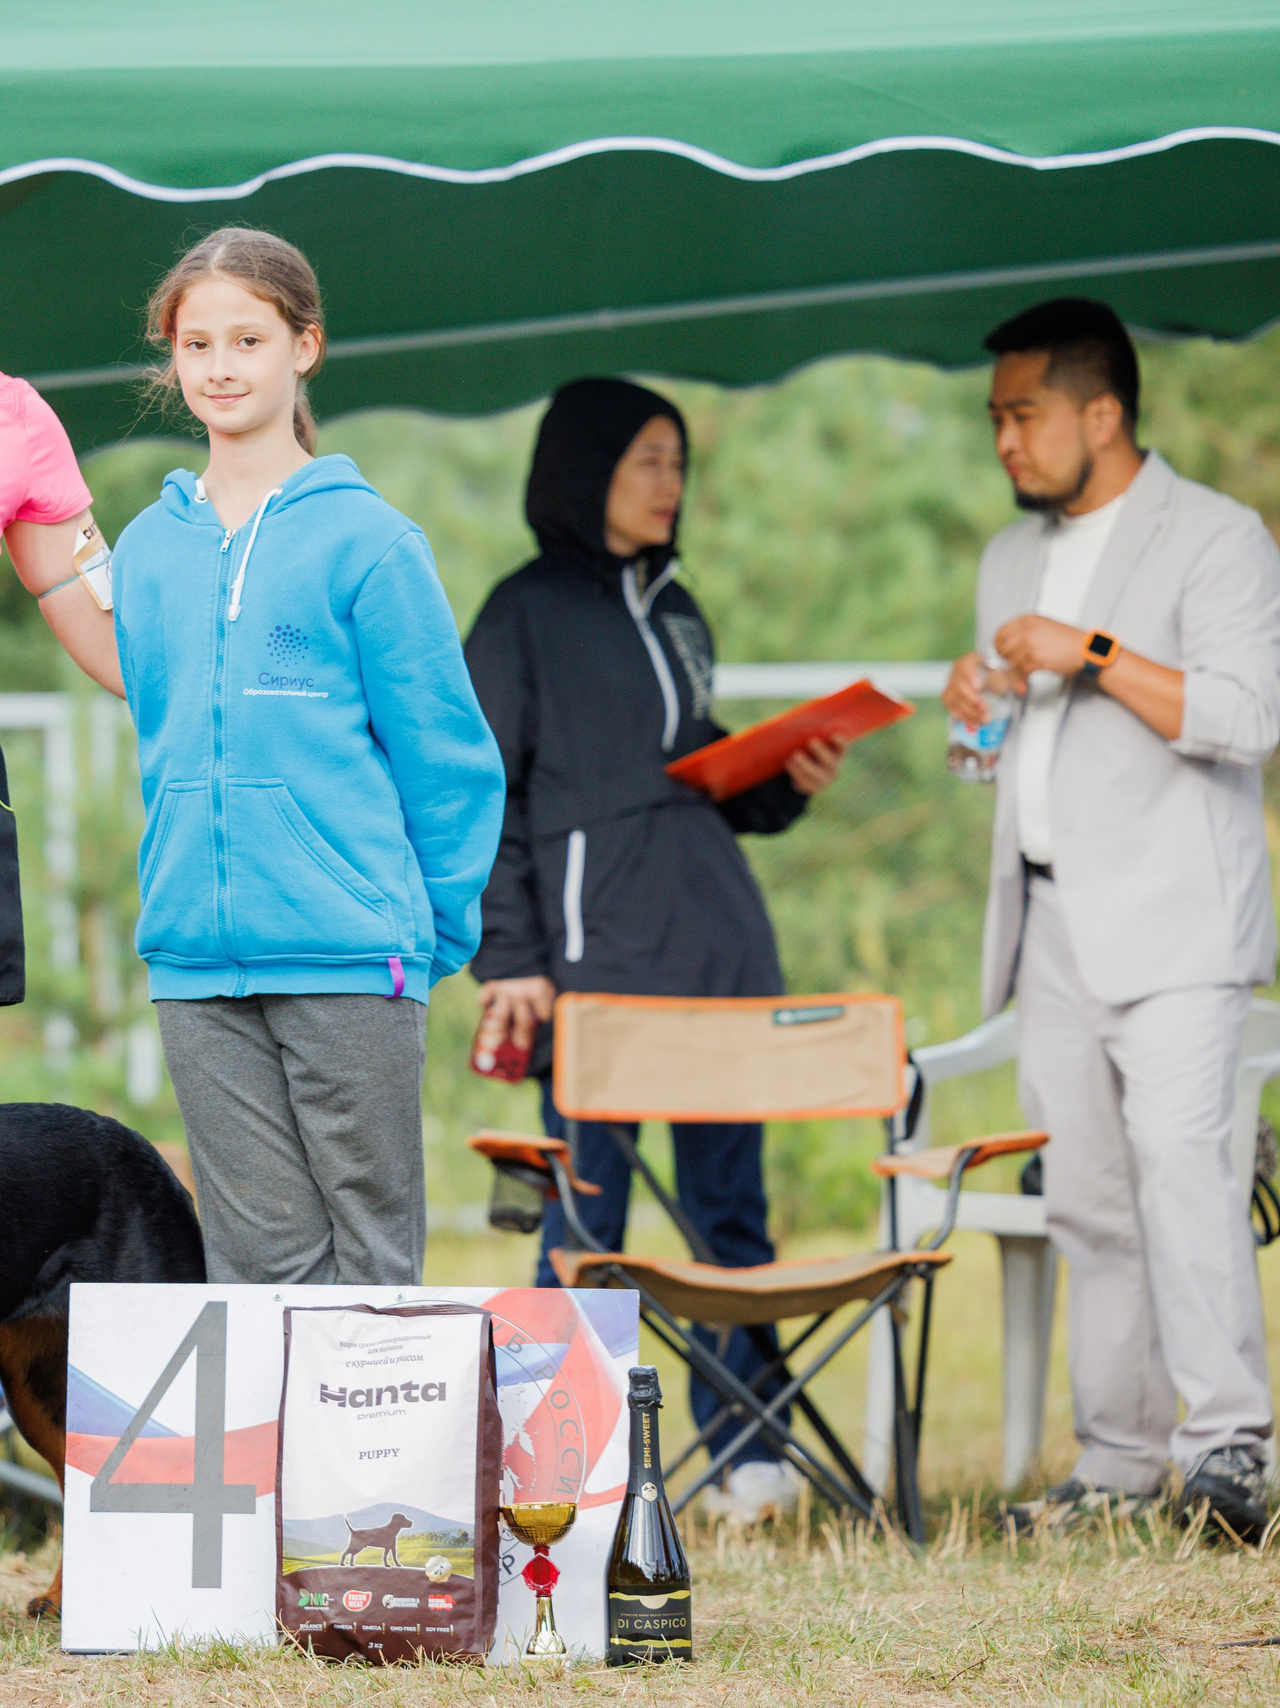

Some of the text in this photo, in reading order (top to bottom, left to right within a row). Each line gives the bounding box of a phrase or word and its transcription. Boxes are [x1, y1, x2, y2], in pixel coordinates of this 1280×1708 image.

[258, 672, 315, 689] Сириус
[243, 688, 307, 697] Образовательный
[339, 1340, 358, 1349] Корм
[351, 1356, 389, 1368] курицей
[396, 1354, 424, 1364] рисом
[320, 1380, 447, 1408] Hanta
[357, 1409, 407, 1420] premium
[90, 1301, 257, 1588] 4
[642, 1412, 652, 1469] SEMI-SWEET
[358, 1448, 400, 1460] PUPPY
[618, 1617, 687, 1630] DI CASPICO
